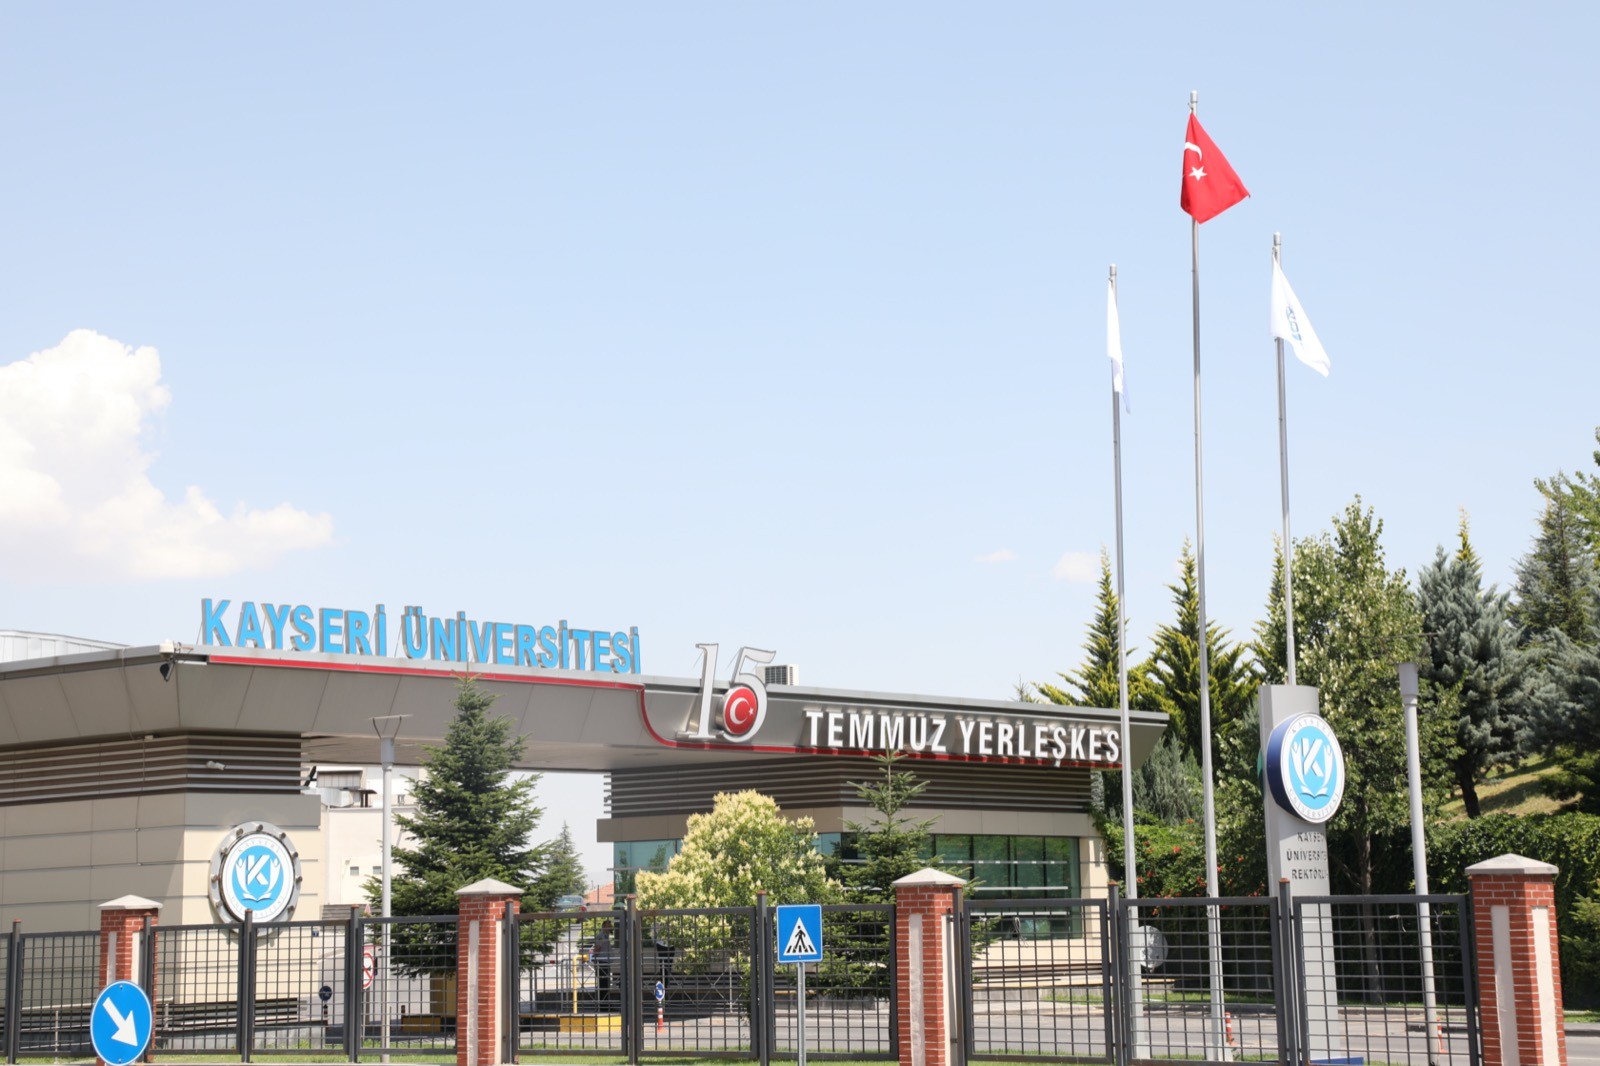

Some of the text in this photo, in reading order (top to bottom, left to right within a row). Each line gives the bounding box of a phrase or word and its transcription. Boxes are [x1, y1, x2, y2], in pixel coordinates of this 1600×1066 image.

[201, 597, 642, 675] KAYSERİ ÜNİVERSİTESİ
[676, 643, 1120, 767] 15 TEMMUZ YERLEŞKES
